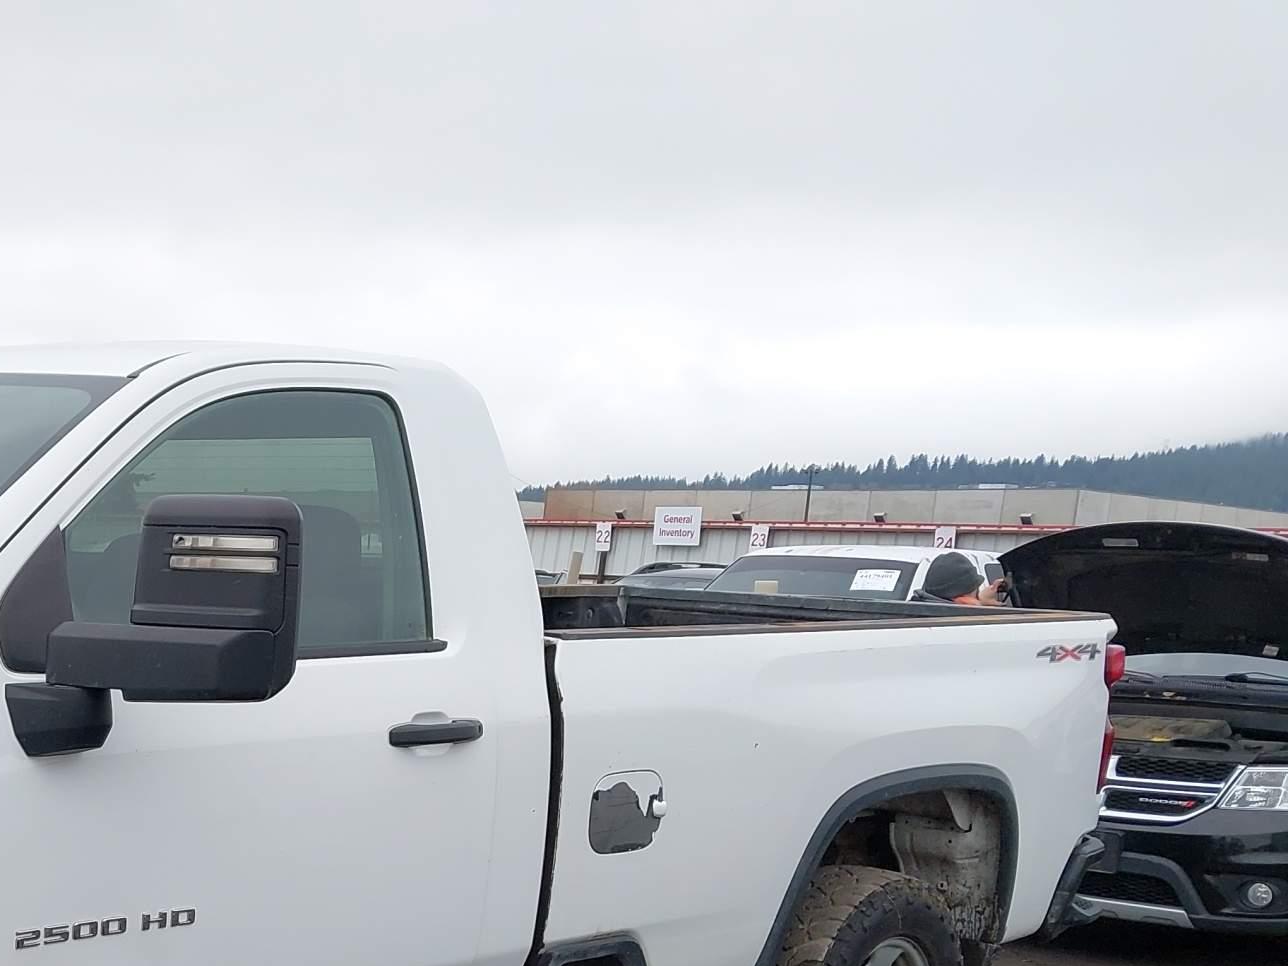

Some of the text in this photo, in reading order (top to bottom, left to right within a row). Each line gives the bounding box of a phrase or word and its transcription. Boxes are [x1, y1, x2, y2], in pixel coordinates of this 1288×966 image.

[663, 514, 693, 524] General
[596, 530, 610, 543] 22
[659, 528, 695, 539] Inventory
[751, 533, 766, 547] 23
[936, 536, 953, 548] 24
[15, 908, 196, 950] 2500 HD
